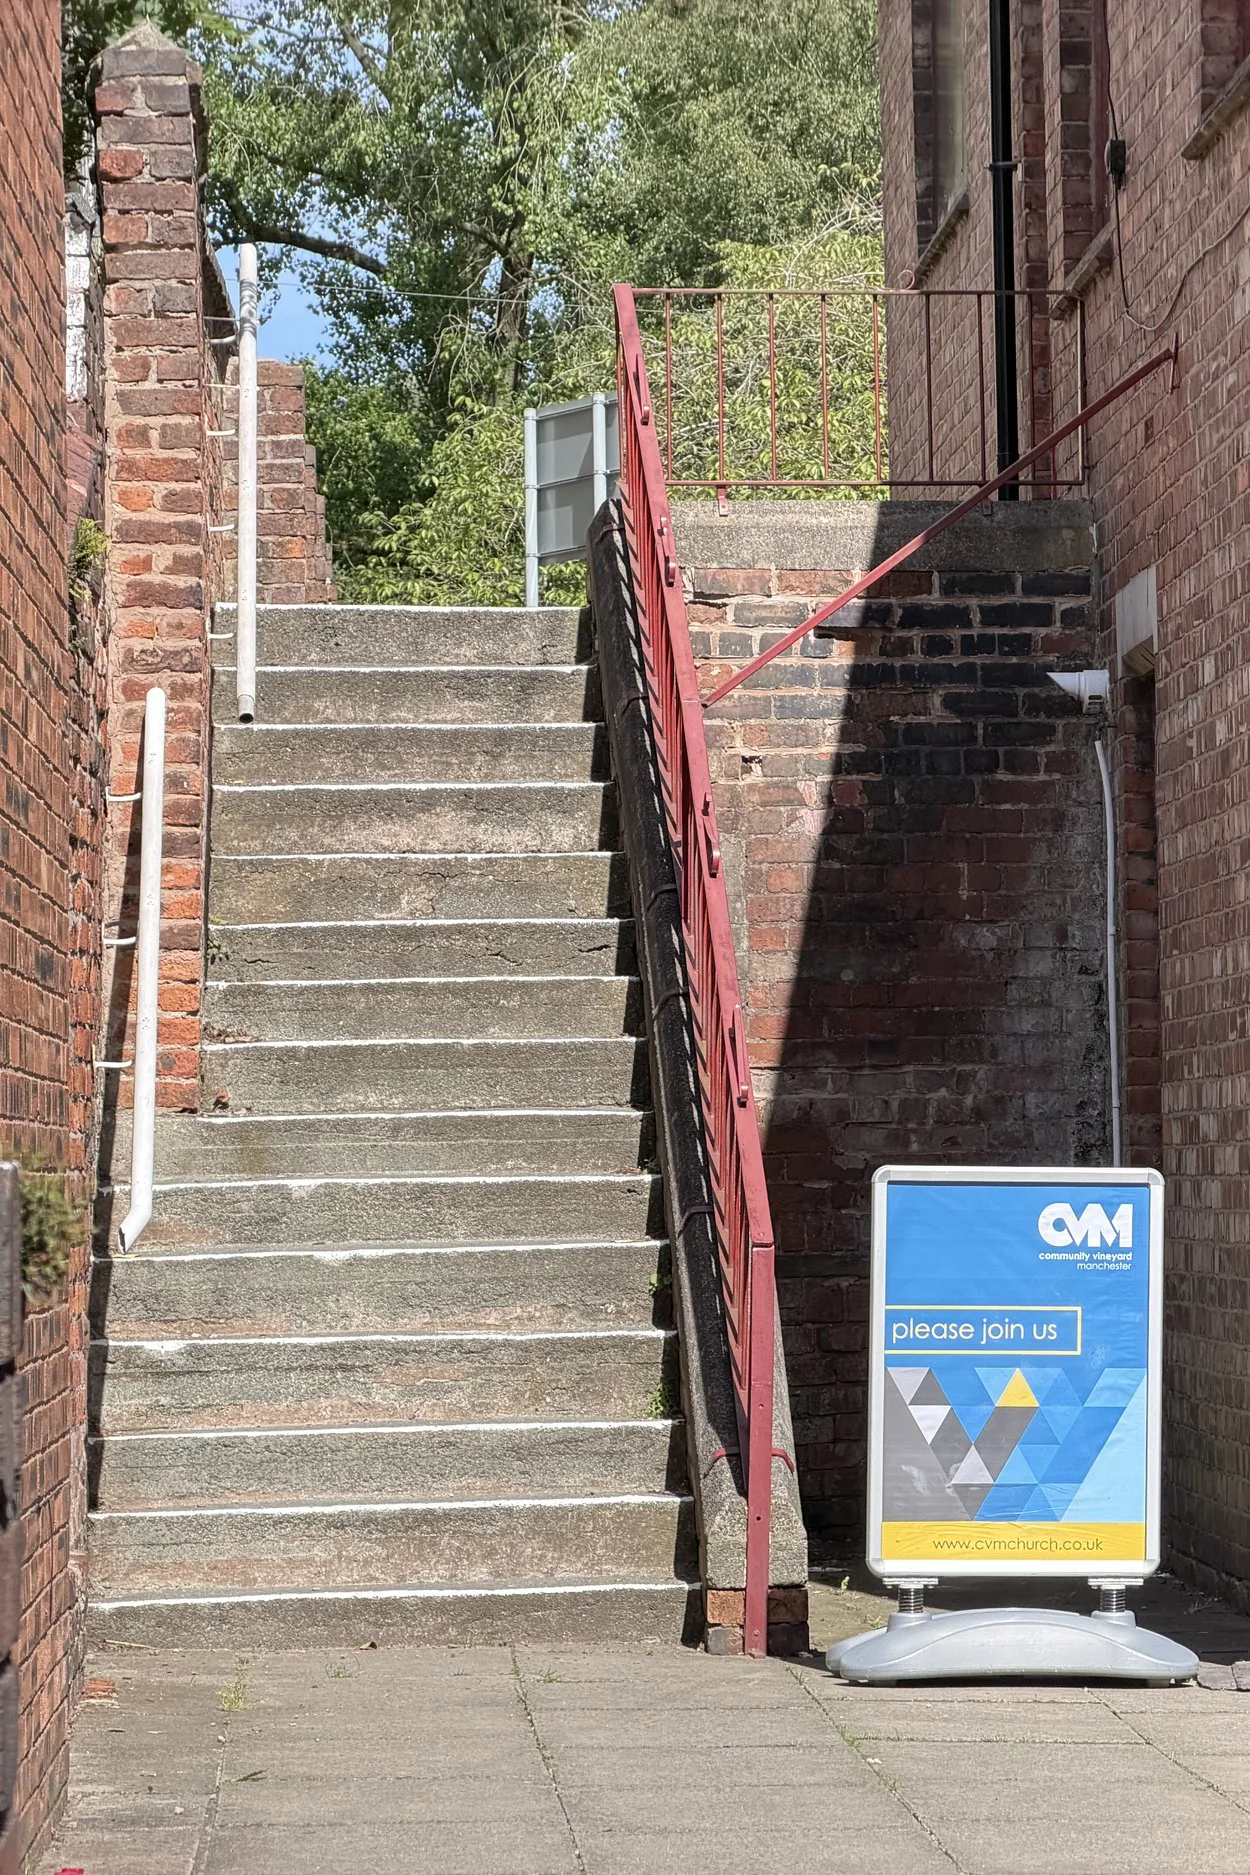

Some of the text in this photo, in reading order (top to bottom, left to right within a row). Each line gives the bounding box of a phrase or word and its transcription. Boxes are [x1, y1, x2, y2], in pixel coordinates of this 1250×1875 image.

[1038, 1202, 1133, 1248] CVM
[1039, 1252, 1132, 1261] community vineyard
[1077, 1262, 1132, 1270] manchester
[892, 1318, 1057, 1344] please join us
[933, 1538, 1103, 1552] www.cvmchurch.co.uk
